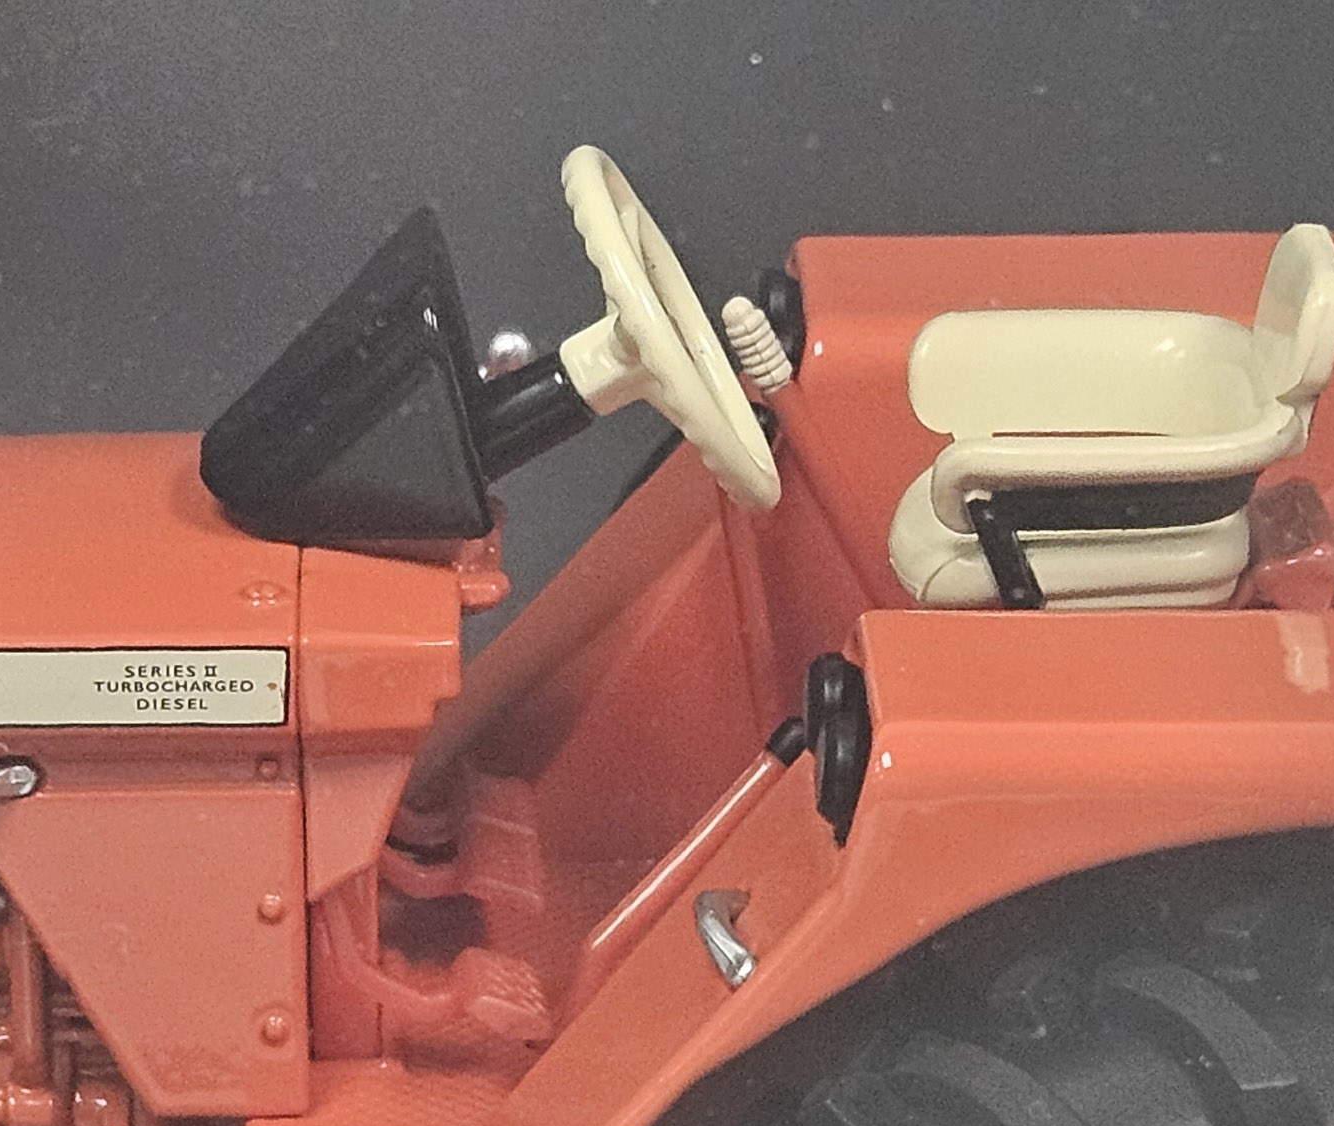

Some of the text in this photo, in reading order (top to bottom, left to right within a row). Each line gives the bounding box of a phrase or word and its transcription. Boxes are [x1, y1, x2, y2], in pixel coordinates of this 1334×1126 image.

[124, 664, 197, 678] SERIES
[94, 680, 255, 693] TURBOCHARGED
[136, 698, 209, 711] DIESEL
